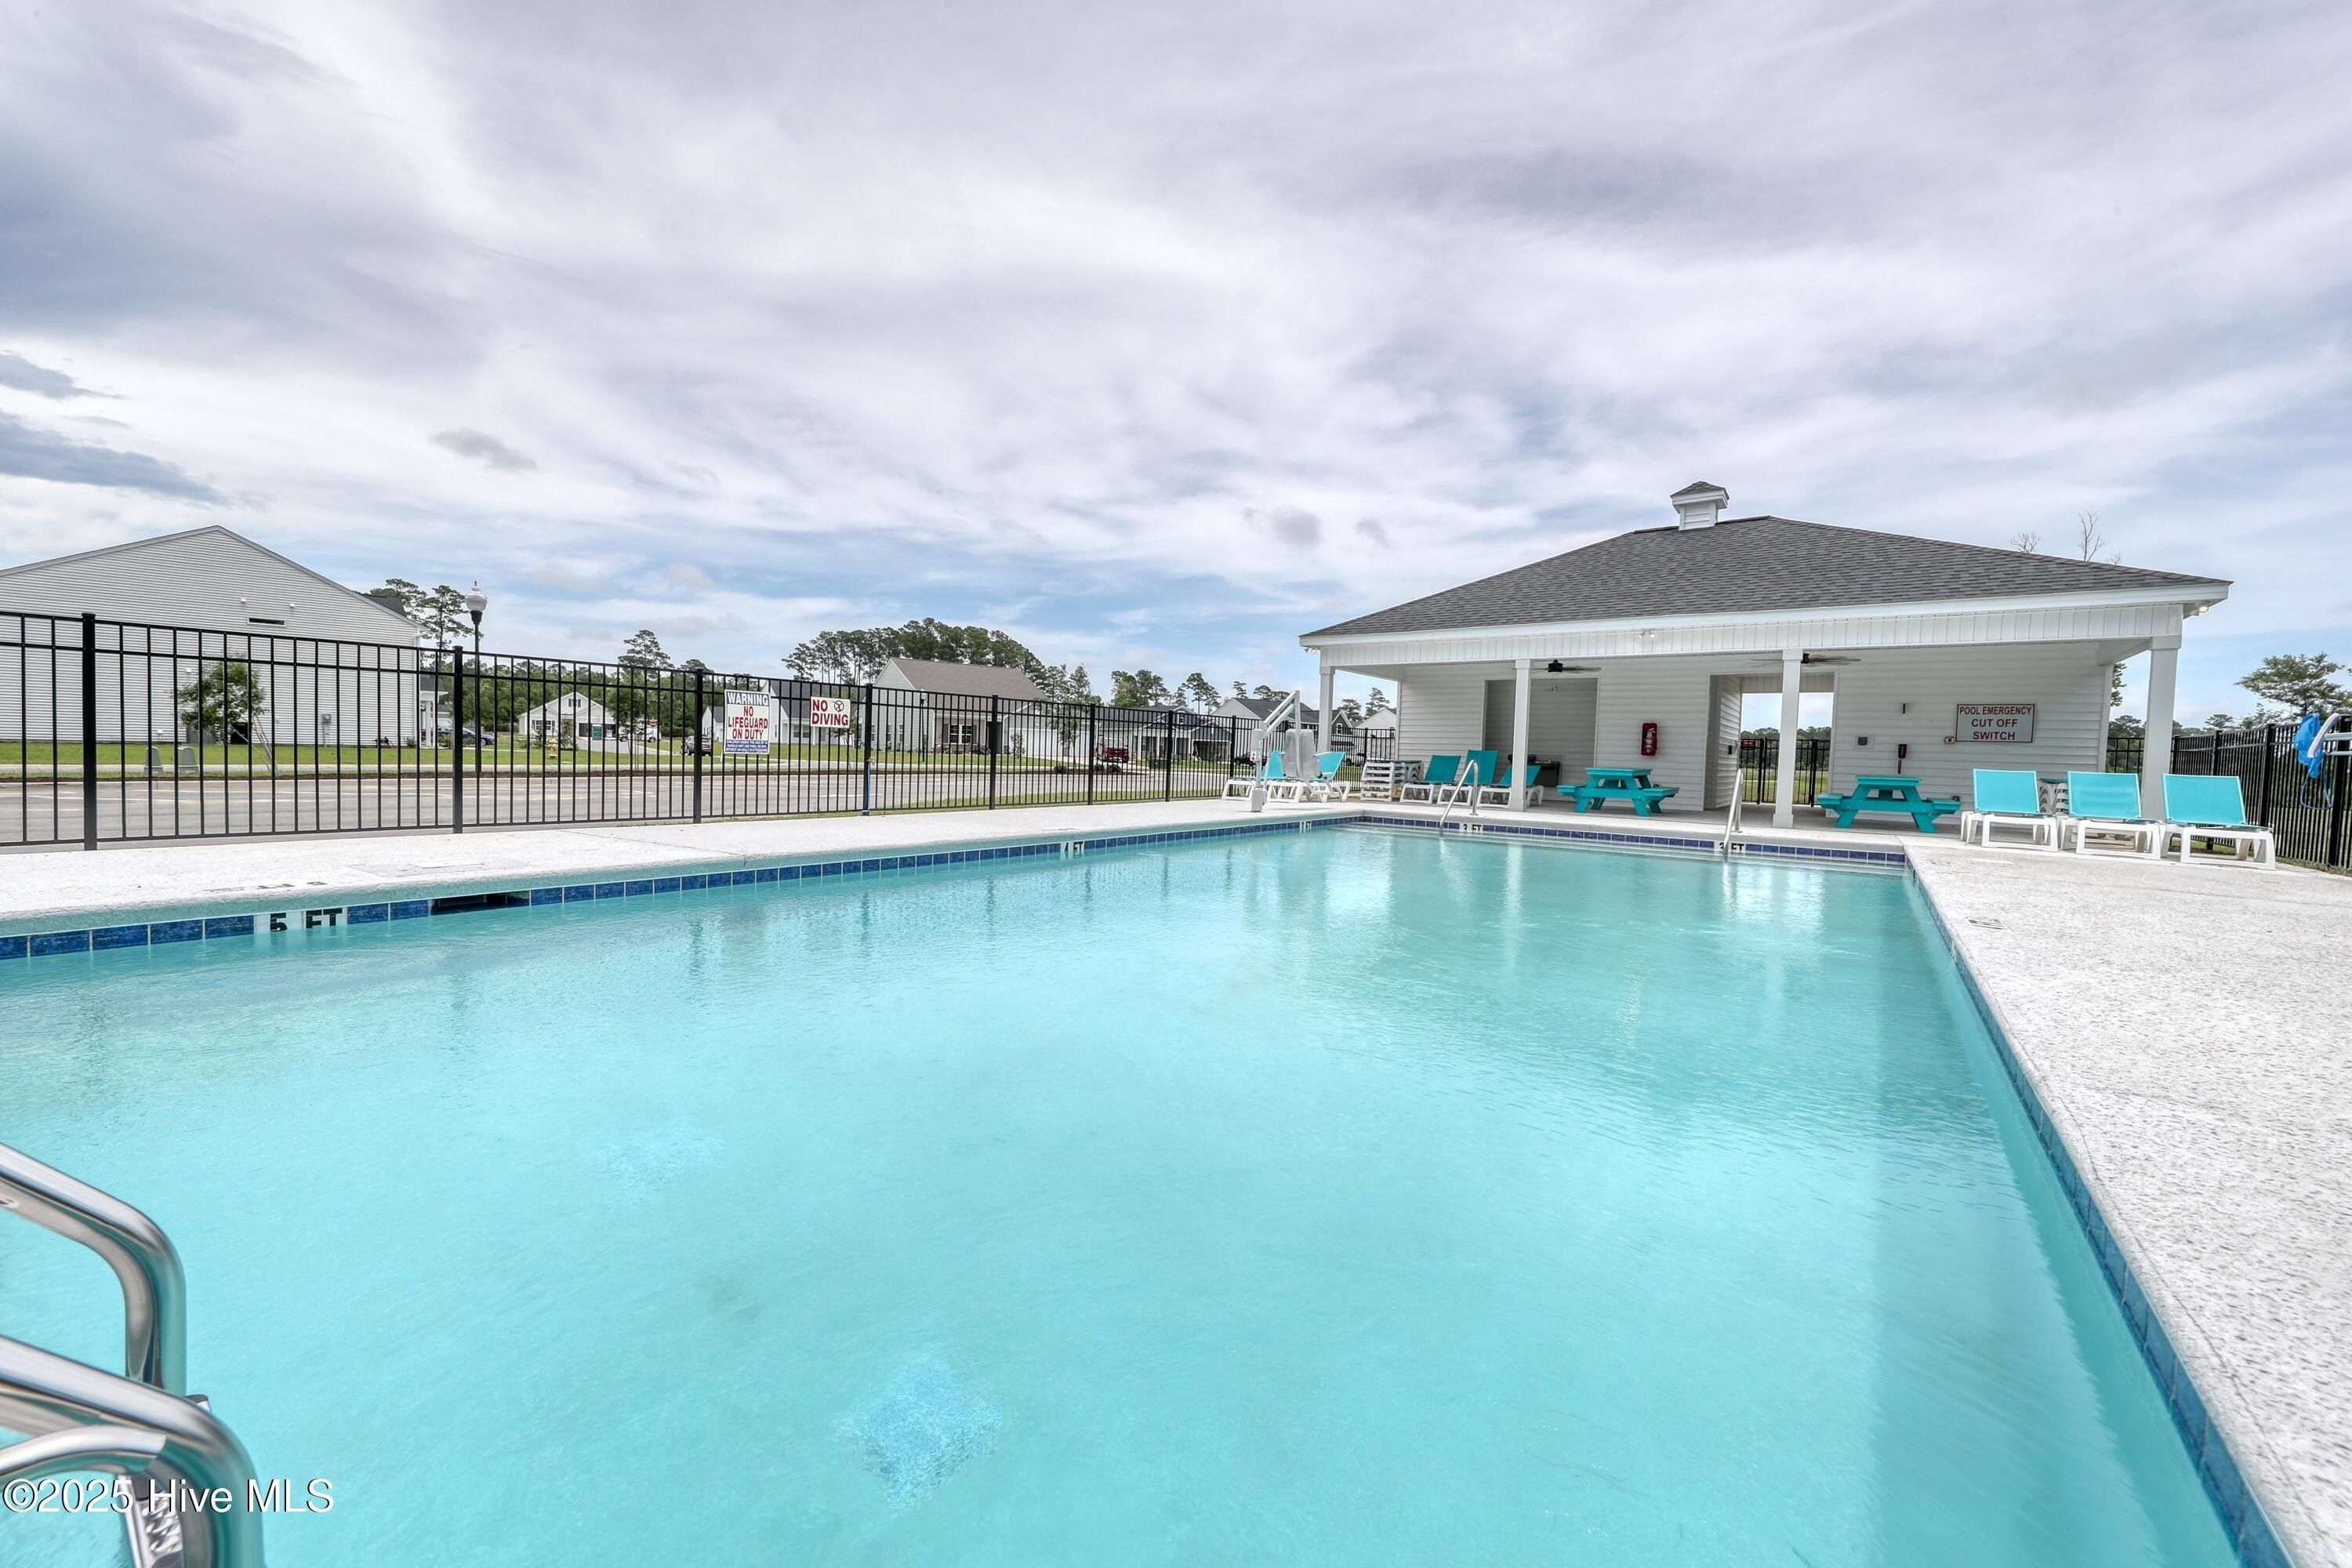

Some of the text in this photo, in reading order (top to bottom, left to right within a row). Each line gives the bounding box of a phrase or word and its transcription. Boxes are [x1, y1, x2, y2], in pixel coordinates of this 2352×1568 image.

[728, 692, 768, 706] WARNING
[812, 699, 828, 711] NO
[743, 706, 753, 717] NO
[1959, 706, 2032, 715] POOL EMERGENCY
[728, 717, 768, 729] LIFEGUARD
[811, 713, 849, 726] DIVING
[1971, 718, 2019, 728] CUT OFF
[732, 728, 764, 740] ON DUTY
[1973, 731, 2016, 740] SWITCH
[1731, 842, 1744, 851] FT
[270, 908, 343, 931] 5 FT
